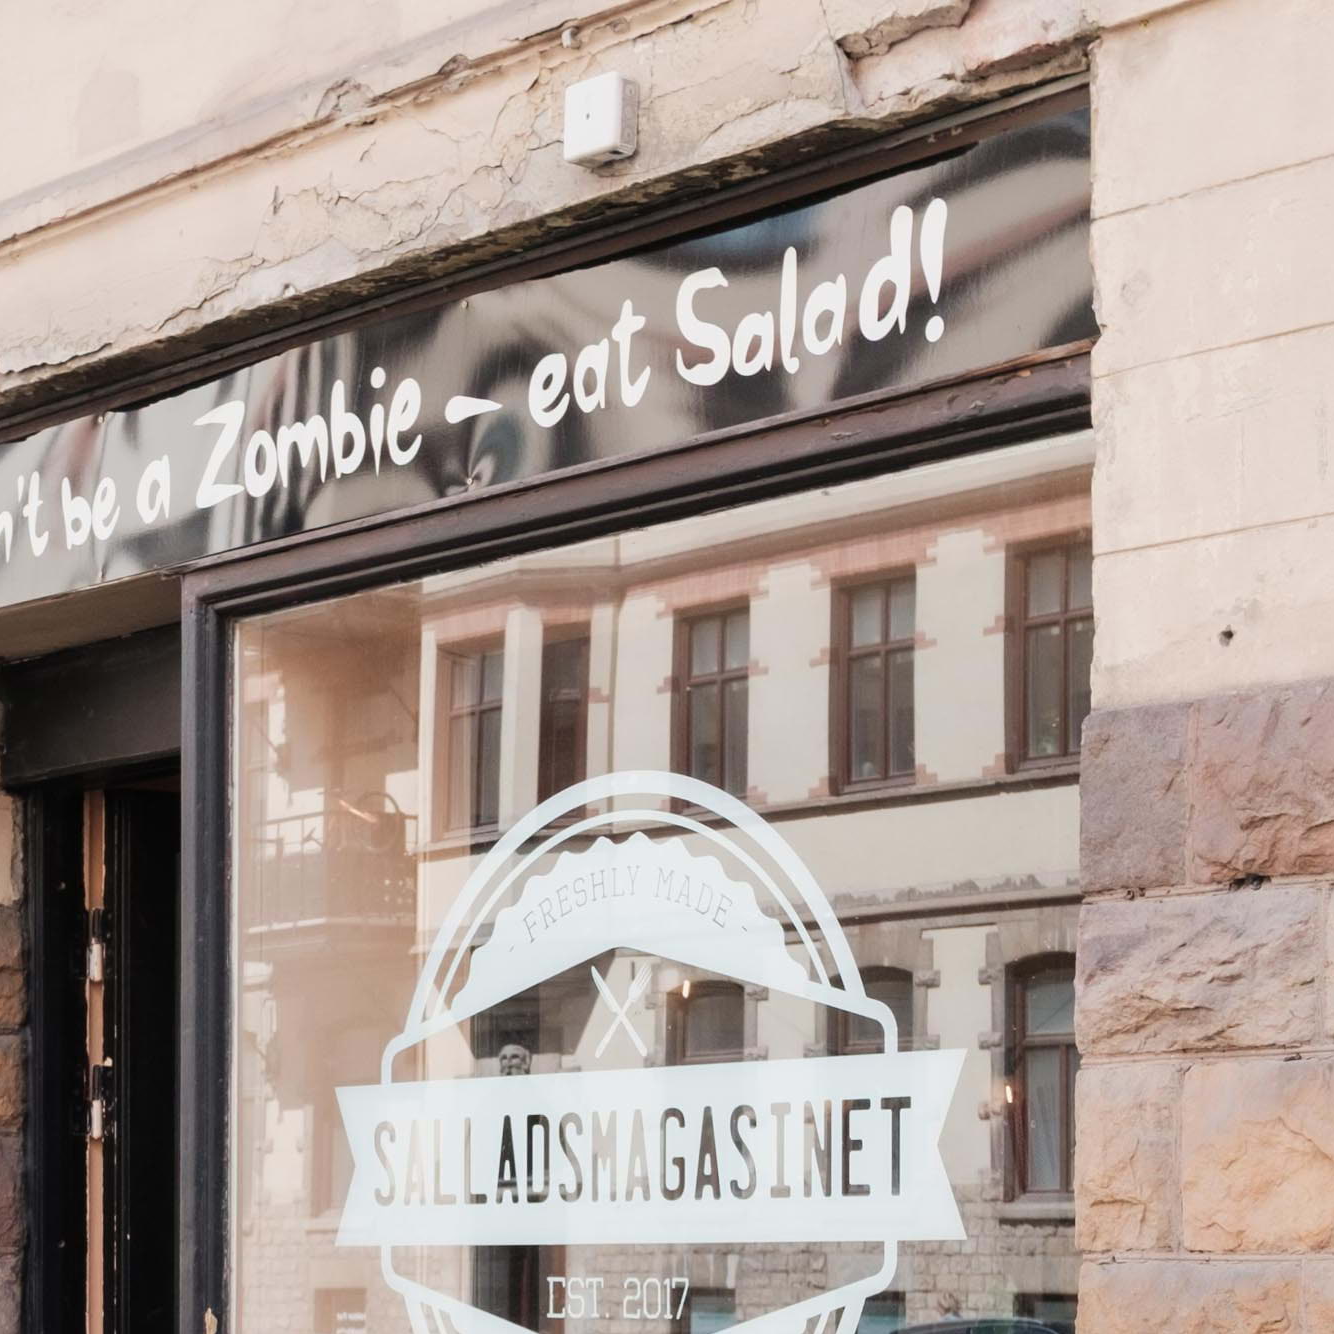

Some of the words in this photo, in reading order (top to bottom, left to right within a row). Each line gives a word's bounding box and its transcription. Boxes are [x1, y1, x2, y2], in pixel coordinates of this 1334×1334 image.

[61, 476, 121, 550] be
[136, 453, 171, 525] a
[192, 366, 422, 509] Zombie
[528, 298, 651, 428] eat
[674, 197, 949, 387] Salad!
[522, 865, 641, 944] FRESHLY
[654, 866, 733, 929] MADE
[372, 1096, 912, 1208] SALLADSMAGASINET
[546, 1276, 610, 1319] EST.
[623, 1277, 689, 1320] 2017
